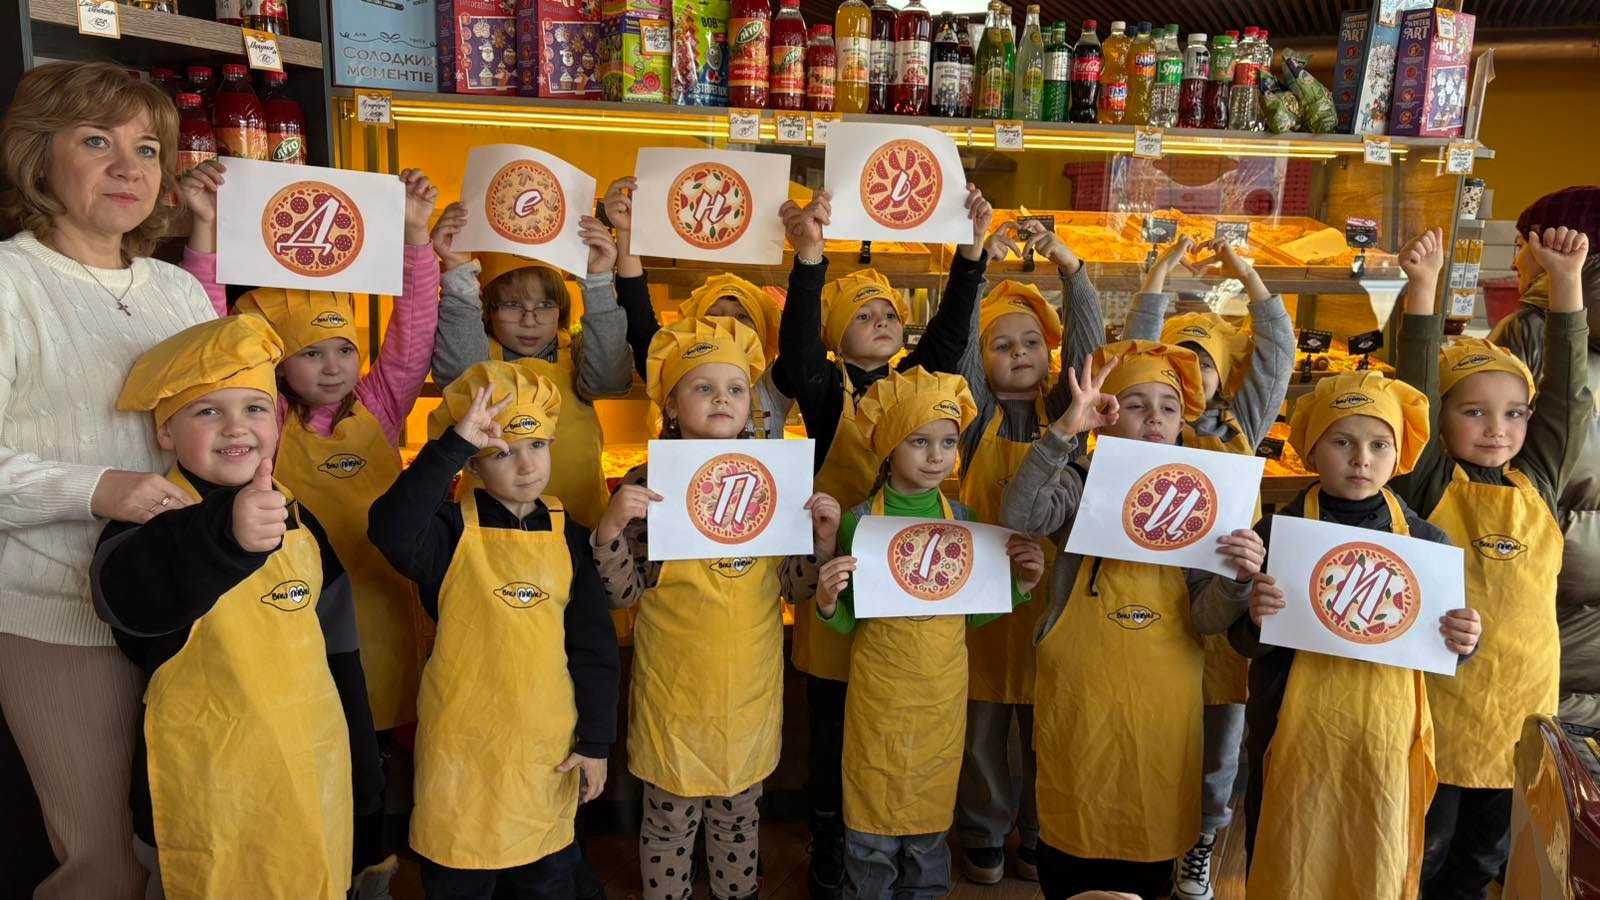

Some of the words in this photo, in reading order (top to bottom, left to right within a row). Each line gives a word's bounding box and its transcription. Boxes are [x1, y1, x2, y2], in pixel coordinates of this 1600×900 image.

[276, 196, 341, 256] Д
[711, 471, 758, 528] П
[1331, 561, 1393, 625] И
